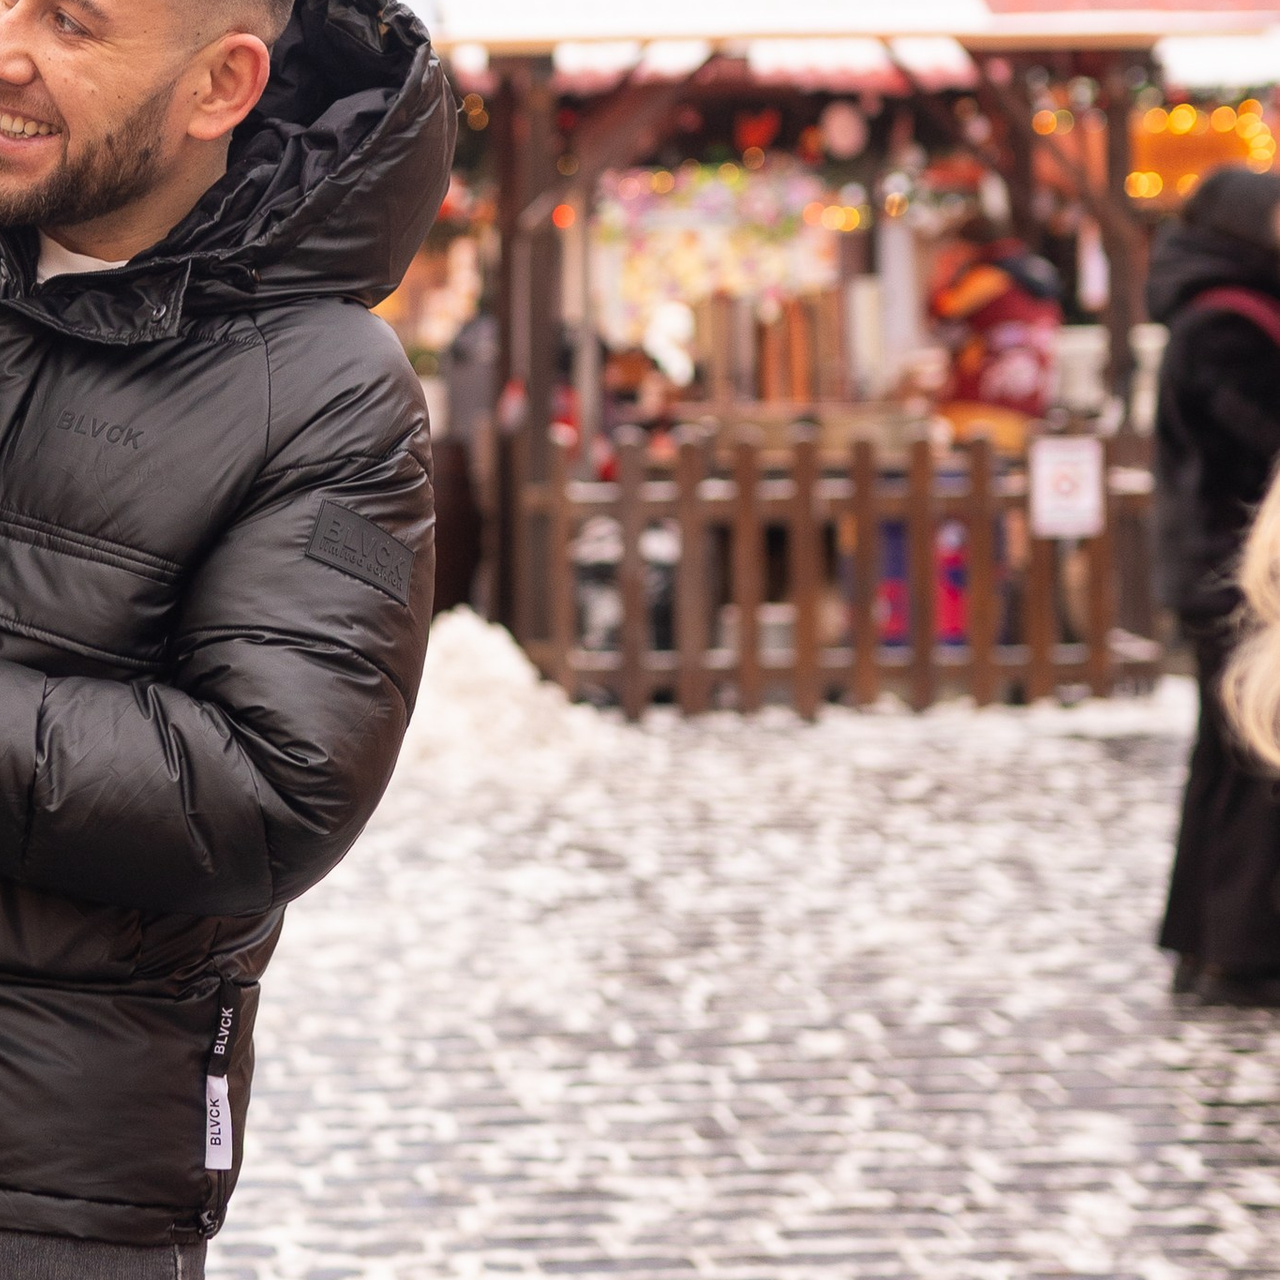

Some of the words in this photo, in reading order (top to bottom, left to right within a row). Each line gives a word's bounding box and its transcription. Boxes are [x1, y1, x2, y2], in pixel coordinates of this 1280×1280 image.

[56, 410, 145, 450] BLVCK
[318, 538, 365, 568] limited
[365, 561, 404, 592] edition
[322, 516, 408, 582] BLVCK
[213, 1006, 234, 1055] BLVCK
[210, 1098, 222, 1146] BLVCK
